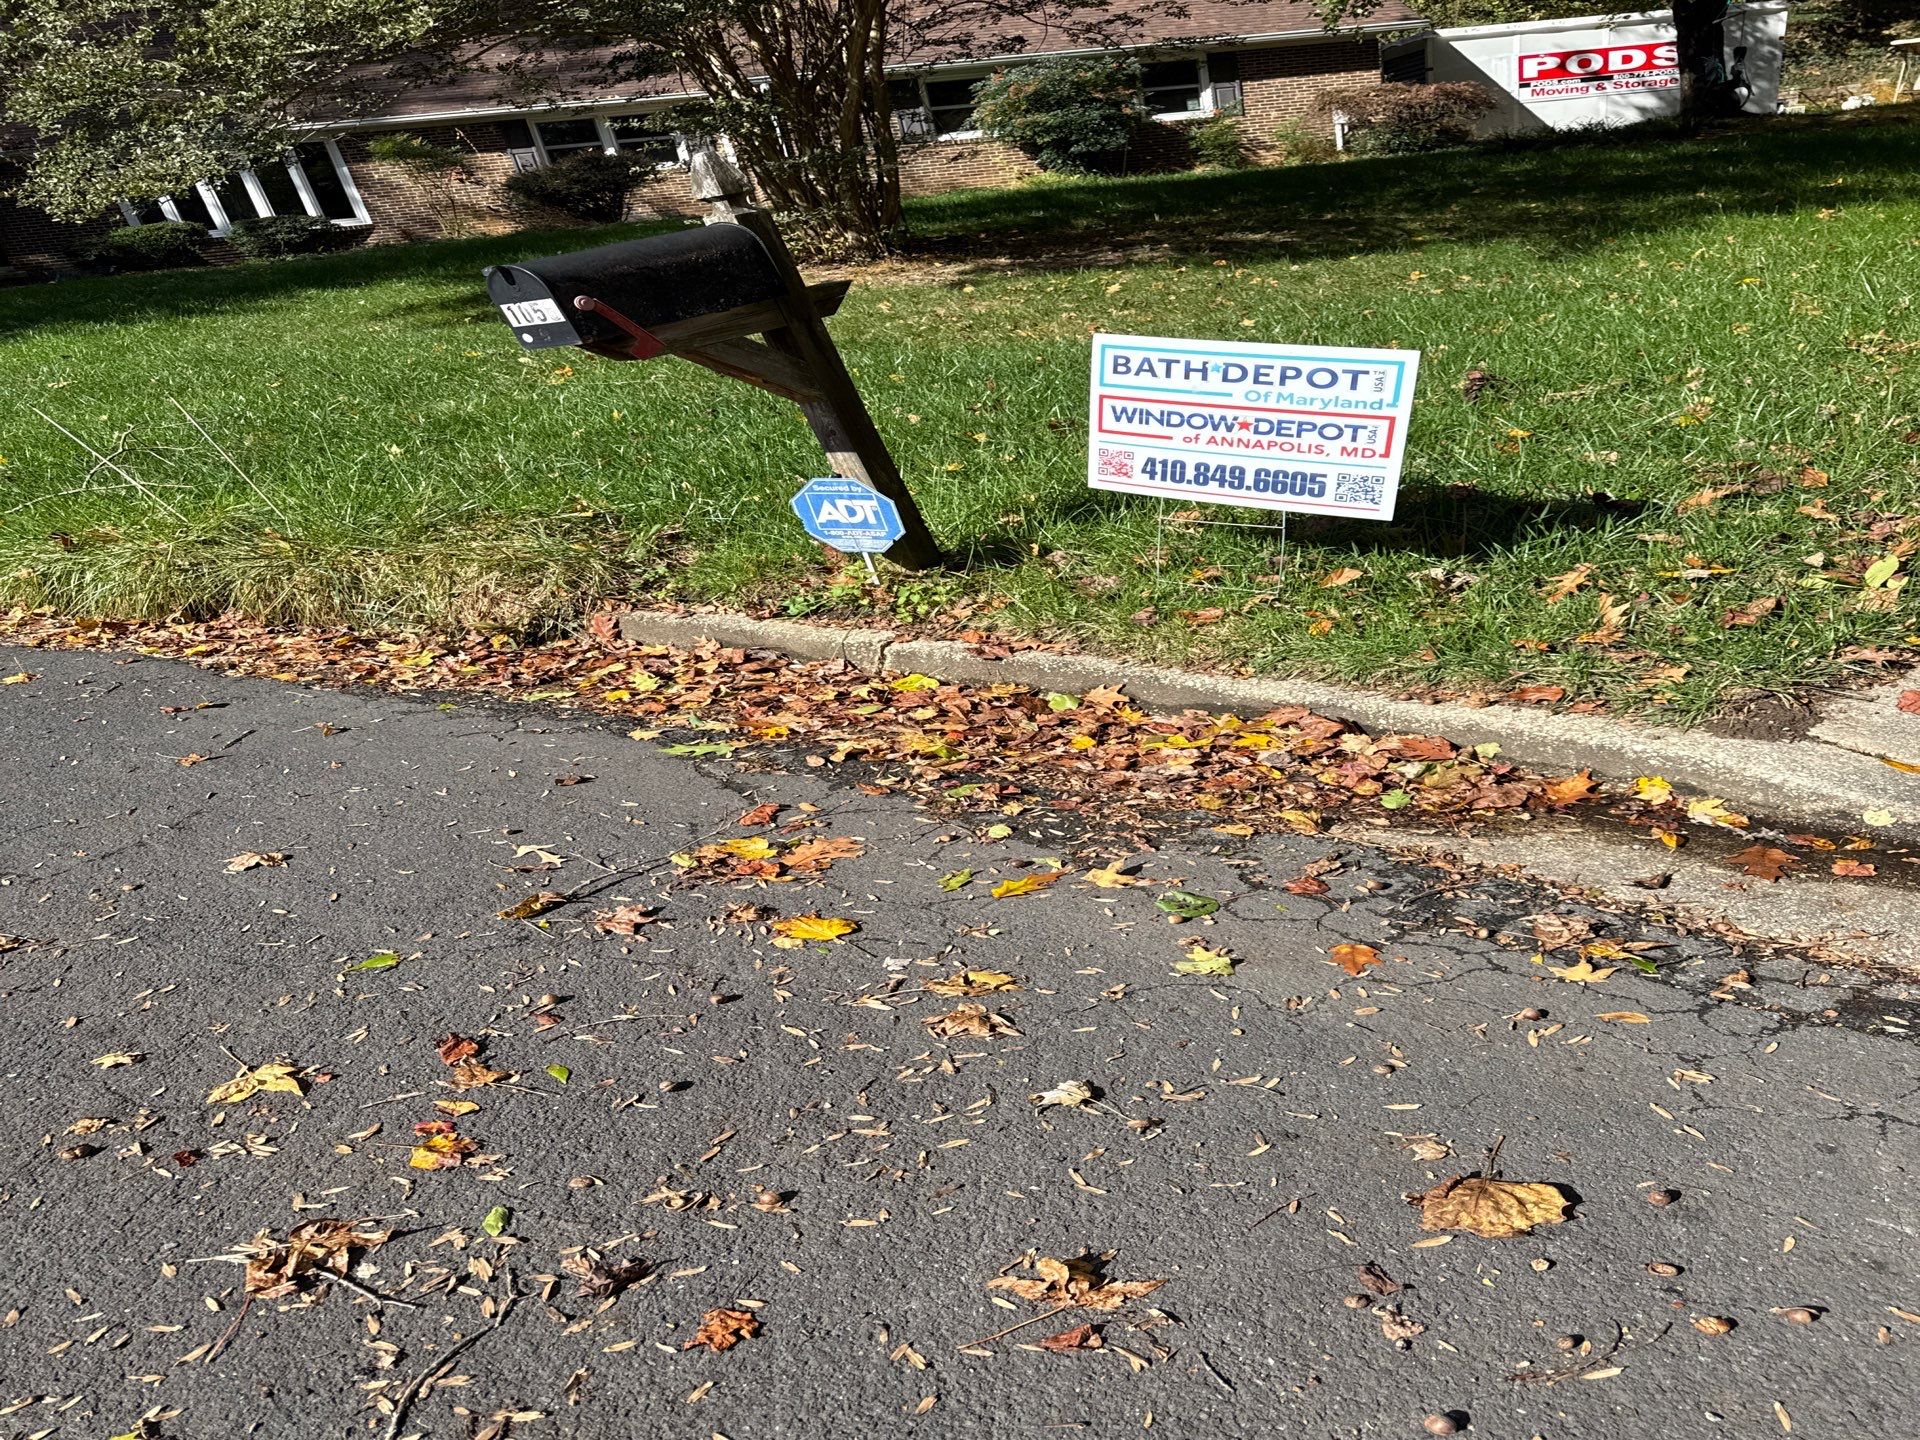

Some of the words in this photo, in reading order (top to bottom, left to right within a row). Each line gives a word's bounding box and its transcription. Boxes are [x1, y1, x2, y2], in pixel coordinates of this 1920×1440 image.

[1522, 45, 1678, 79] PODS
[1530, 78, 1581, 88] PODS.com
[1530, 84, 1590, 97] Moving
[1595, 82, 1607, 92] &
[1613, 77, 1680, 91] Storage
[1112, 355, 1209, 381] BATH
[1221, 362, 1370, 390] DEPOT
[1373, 376, 1385, 393] USA
[1244, 389, 1272, 402] Of
[1275, 392, 1385, 411] Maryland
[1110, 405, 1239, 433] WINDOW
[1252, 417, 1368, 443] DEPOT
[1366, 427, 1378, 445] USA
[1182, 433, 1201, 445] of
[1205, 435, 1330, 457] ANNAPOLIS,
[1340, 446, 1377, 459] MD
[812, 484, 849, 492] Secured
[851, 485, 862, 493] by
[1140, 456, 1328, 498] 410.849.6605
[817, 499, 878, 525] ADT
